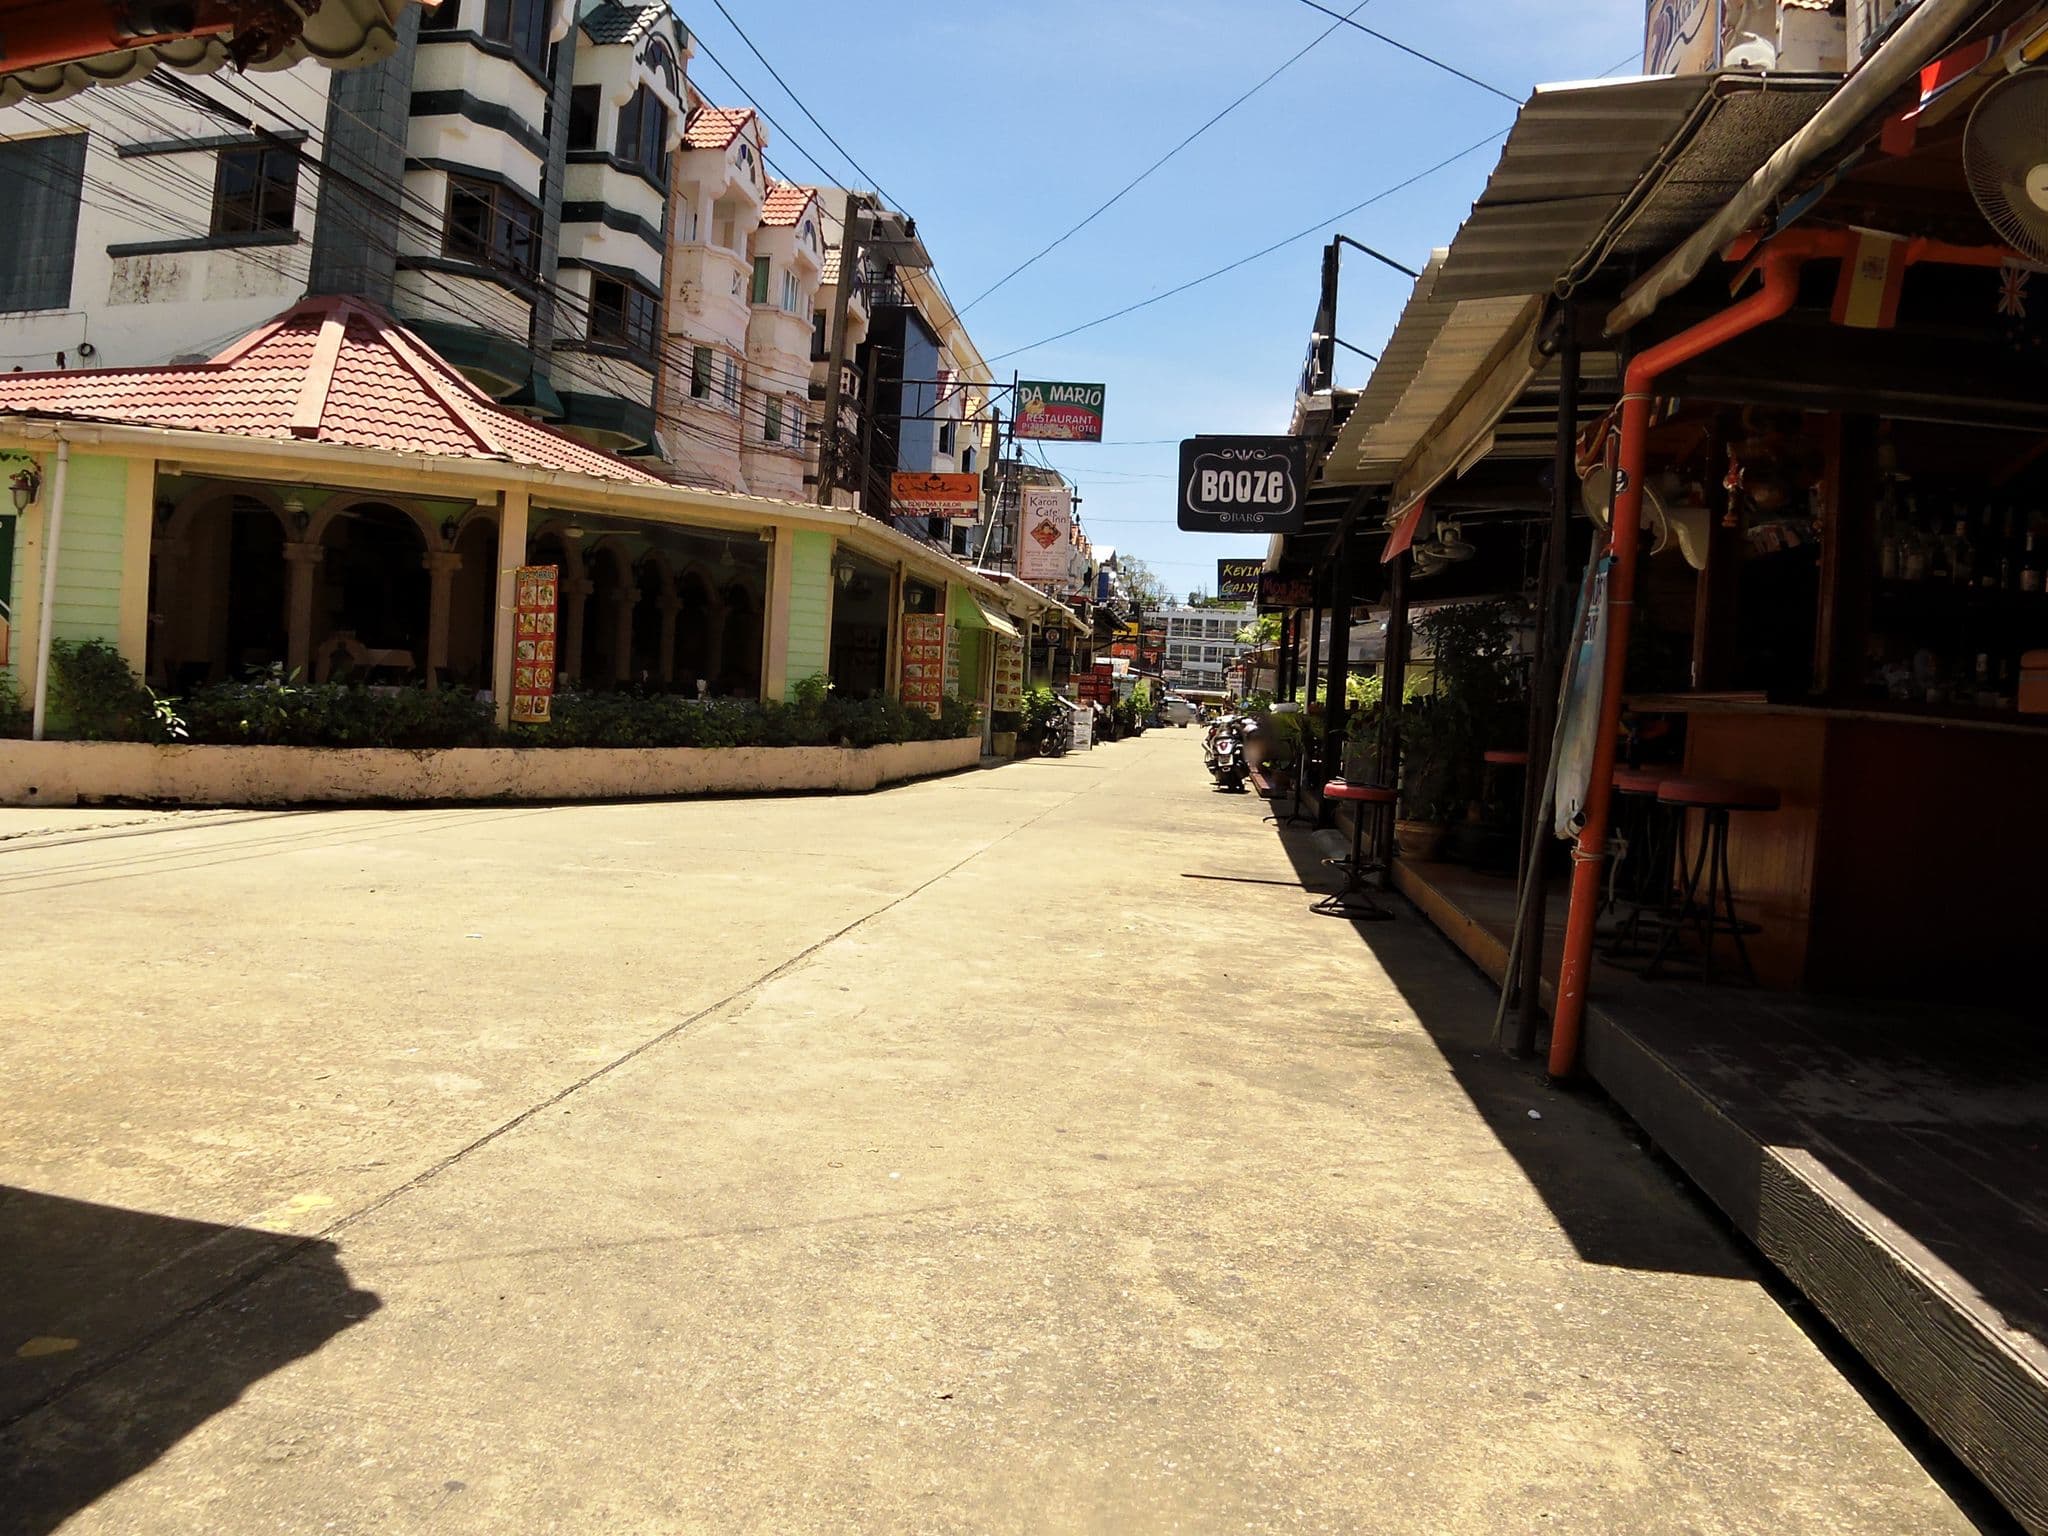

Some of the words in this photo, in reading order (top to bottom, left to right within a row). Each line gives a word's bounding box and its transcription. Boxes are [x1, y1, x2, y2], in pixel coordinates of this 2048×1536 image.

[1020, 386, 1043, 403] DA
[1049, 385, 1102, 406] MARIO
[1026, 413, 1094, 424] RESTAURANT
[1071, 424, 1097, 433] HOTEL
[1030, 496, 1058, 507] Karon
[1052, 515, 1066, 524] Inn
[1231, 512, 1253, 522] BAR
